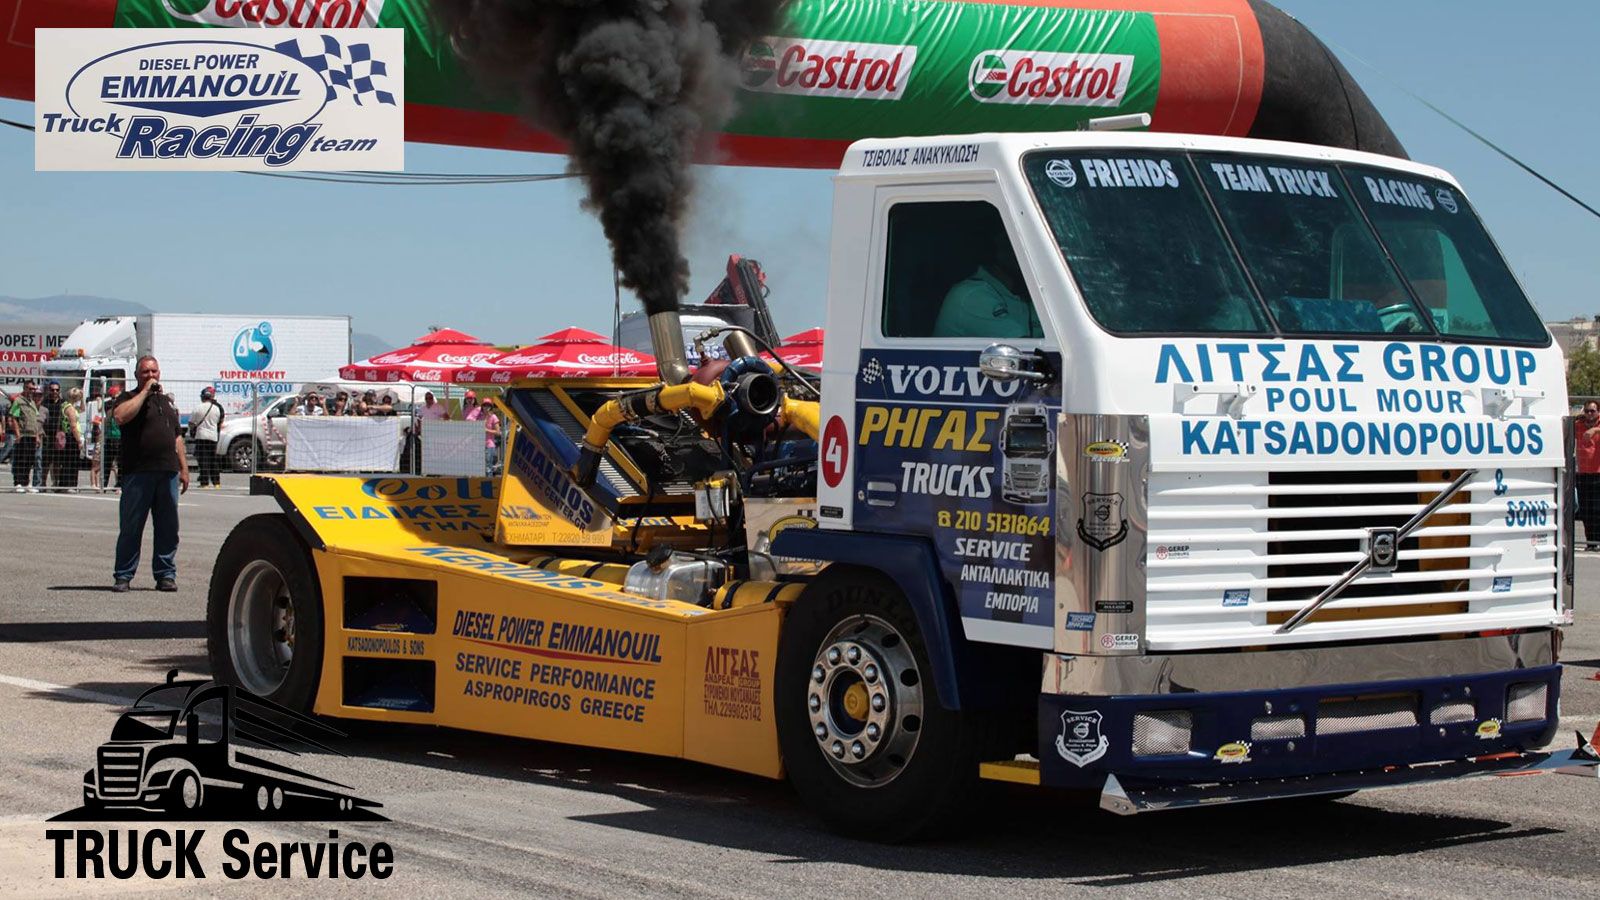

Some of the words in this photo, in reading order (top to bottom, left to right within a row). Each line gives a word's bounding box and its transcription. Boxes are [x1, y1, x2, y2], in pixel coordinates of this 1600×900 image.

[777, 45, 903, 92] Castrol
[1006, 58, 1121, 100] Castrol
[863, 147, 910, 168] ΤΣΙΒΟΛΑΣ
[911, 144, 981, 166] ΑΝΑΚΥΚΛΩΣΗ
[1082, 159, 1180, 188] FRIENDS
[1211, 162, 1270, 194] TEAM
[1269, 166, 1338, 198] TRUCK
[1363, 175, 1435, 211] RACING
[220, 371, 248, 379] SUPER
[250, 371, 286, 379] MARKET
[578, 353, 641, 364] Coca-Cola
[1154, 343, 1364, 384] ΛΙΤΣΑΣ
[1383, 342, 1537, 386] GROUP
[887, 364, 1021, 398] VOLVO
[1266, 387, 1357, 413] POUL
[1377, 388, 1466, 414] MOUR
[858, 406, 1000, 453] ΡΗΓΑΣ
[1181, 420, 1544, 455] KATSADONOPOULOS
[826, 438, 842, 474] 4
[515, 431, 594, 525] MALLIOS
[900, 461, 995, 499] TRUCKS
[313, 504, 491, 520] ΕΙΔΙΚΕΣ
[955, 510, 980, 531] 210
[986, 512, 1051, 535] 5131864
[1505, 500, 1550, 528] SONS
[954, 537, 1033, 562] SERVICE
[405, 546, 605, 590] KERDIS
[961, 564, 1050, 589] ΑΝΤΑΛΛΑΚΤΙΚΑ
[985, 592, 1039, 613] ΕΜΠΟΡΙΑ
[452, 609, 495, 642] DIESEL
[497, 614, 543, 649] POWER
[547, 621, 663, 664] EMMANOUIL
[455, 651, 522, 680] SERVICE
[530, 662, 655, 700] PERFORMANCE
[704, 646, 760, 678] ΛΙΤΣΑΣ
[464, 679, 571, 712] ASPROPIRGOS
[580, 697, 645, 723] GREECE
